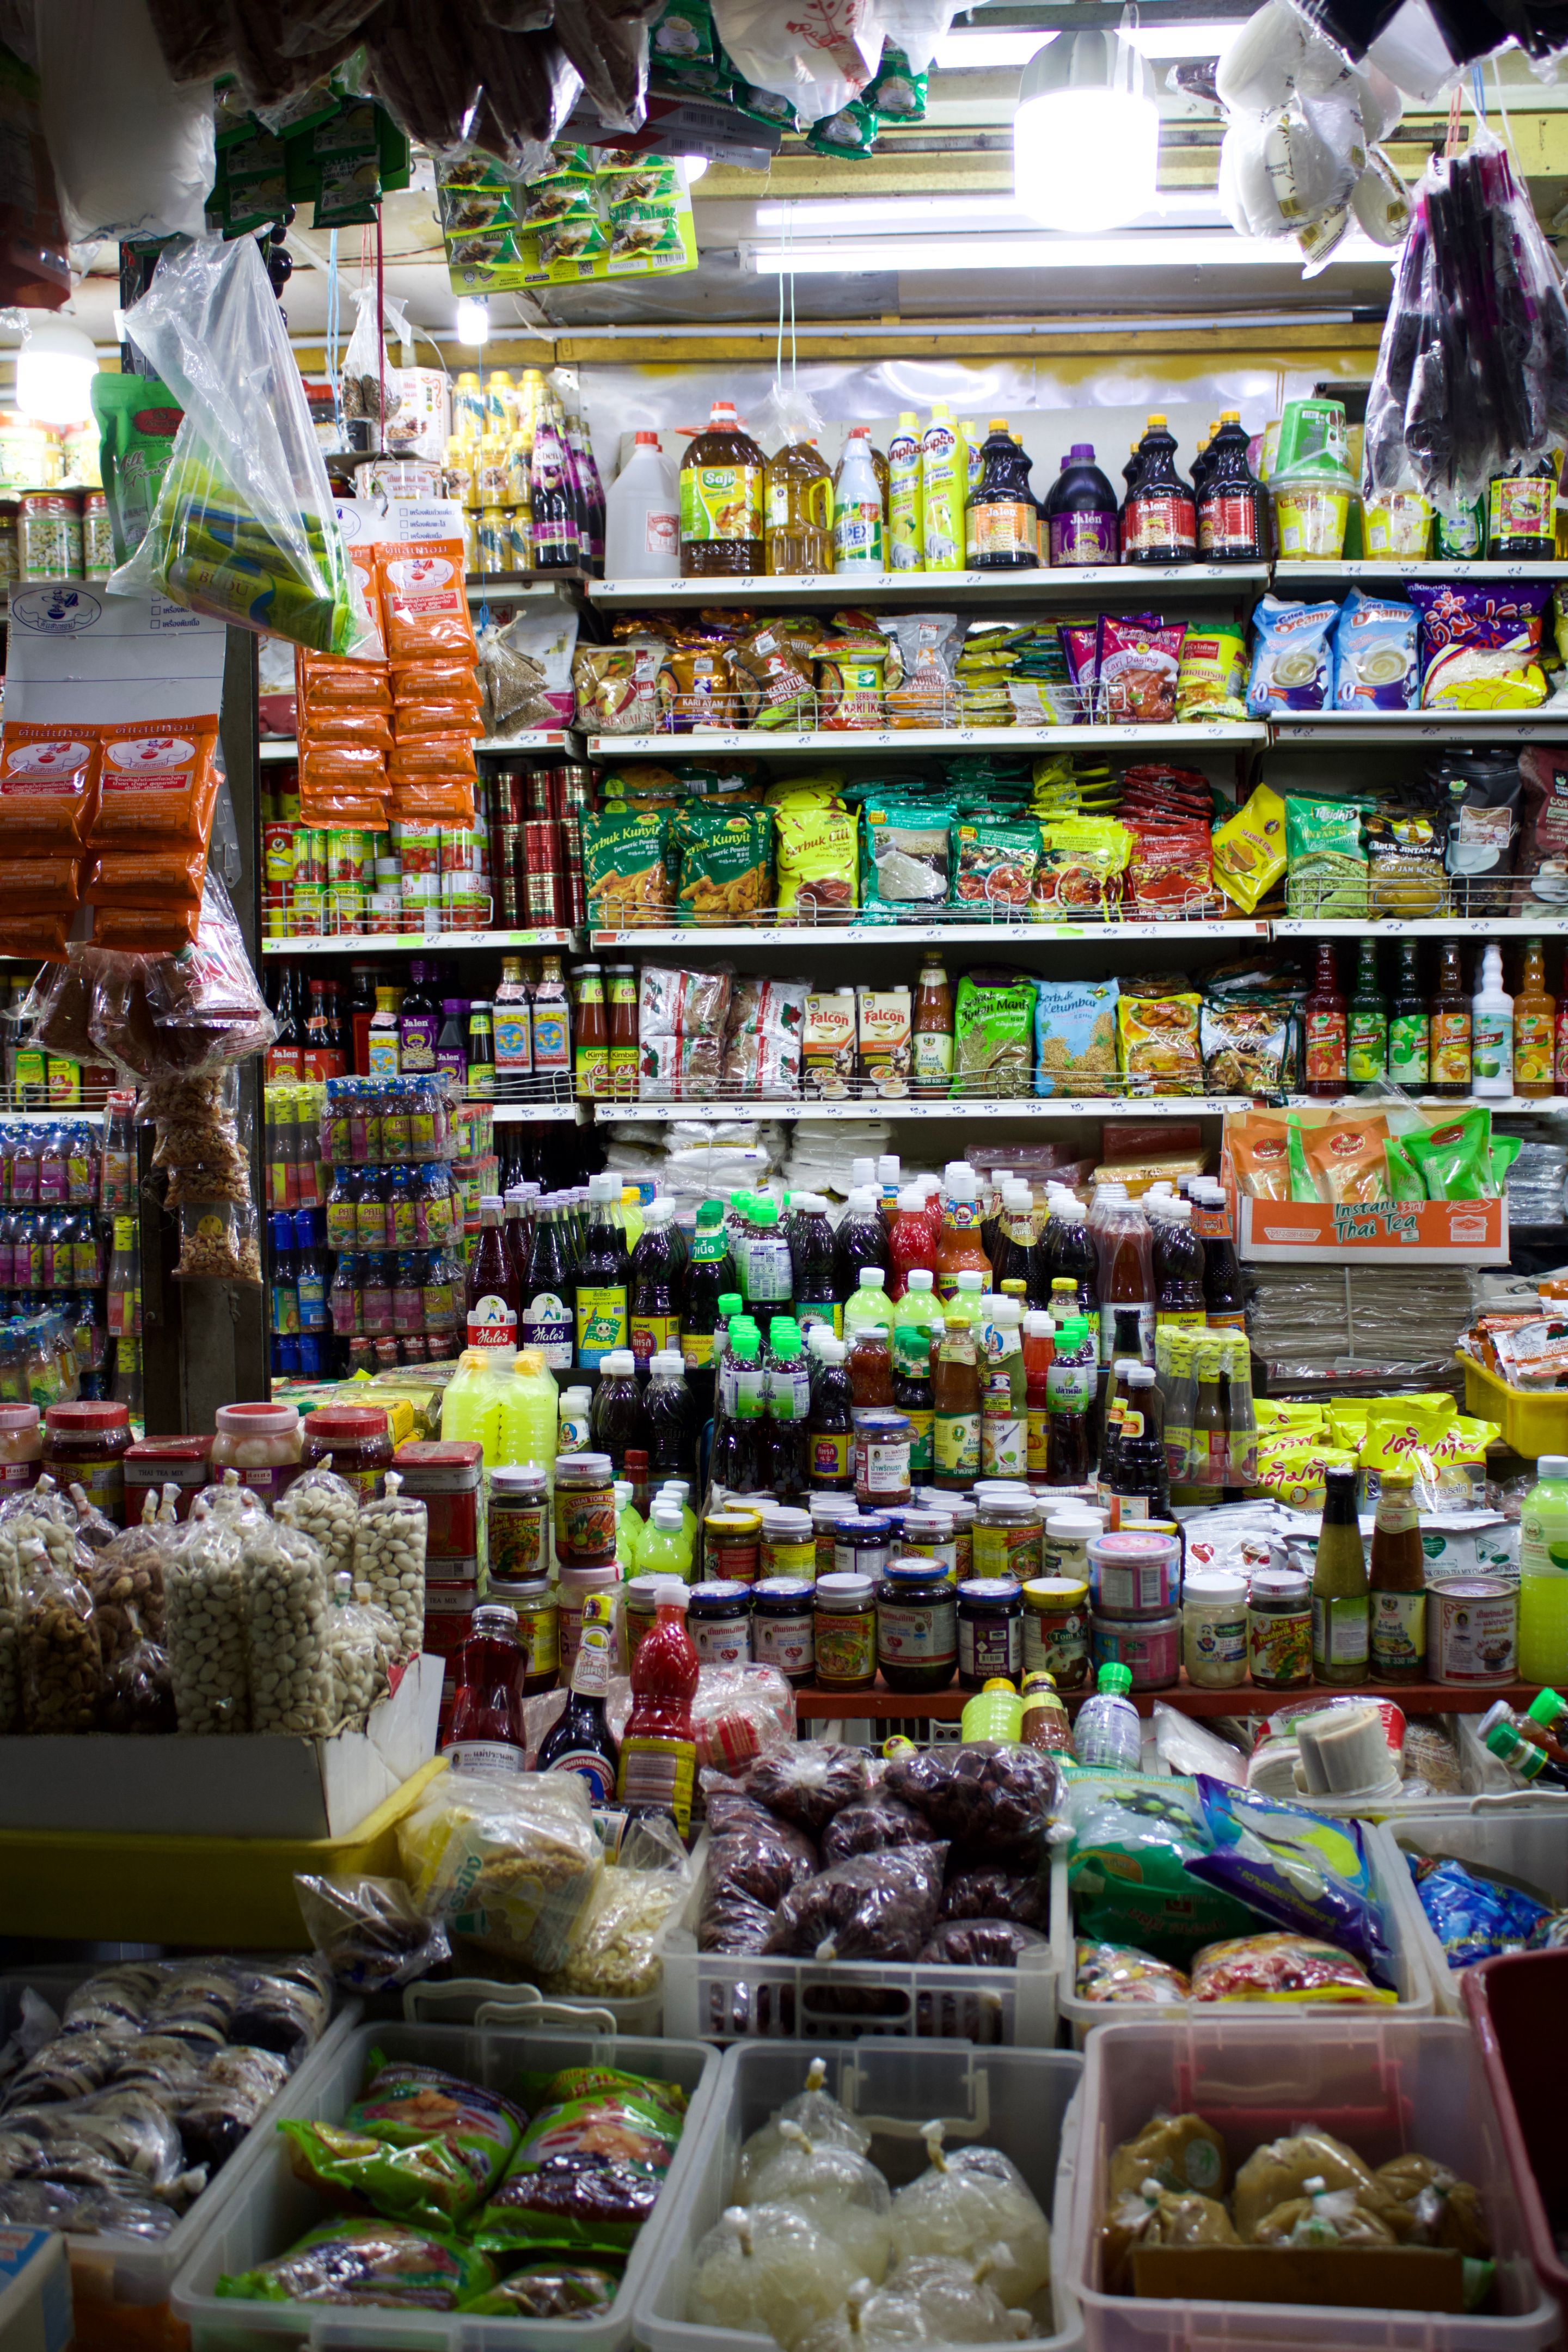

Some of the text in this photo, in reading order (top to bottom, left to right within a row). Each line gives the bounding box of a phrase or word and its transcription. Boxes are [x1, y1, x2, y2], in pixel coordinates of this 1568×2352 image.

[705, 471, 734, 486] Saji
[892, 503, 912, 514] Lemon
[1138, 501, 1167, 513] Jalen
[1070, 513, 1102, 525] Jalen
[1274, 610, 1334, 634] Dreamy
[1104, 655, 1159, 675] Kari Daging
[916, 666, 939, 676] SERBUK
[766, 673, 807, 697] KERUTUK
[911, 674, 947, 685] KURMA
[855, 692, 878, 701] SERBUK
[702, 700, 724, 708] AYAM
[844, 703, 866, 713] KARI
[341, 834, 363, 842] Kimball
[584, 824, 660, 859] Serbuk Kunyit
[712, 832, 751, 846] Kunyit
[613, 838, 660, 854] Turmeric Powder
[785, 827, 850, 861] Serbuk Cili
[729, 846, 750, 854] Powder
[1399, 846, 1430, 854] JINTAN
[996, 999, 1030, 1012] Manis
[1044, 998, 1098, 1017] Ketumbar
[810, 1011, 849, 1027] Falcon
[864, 1009, 905, 1025] Falcon
[403, 1018, 429, 1028] Jalen
[272, 1050, 298, 1059] Jalen
[437, 1052, 460, 1061] Jalen
[1012, 1227, 1031, 1236] อันดับ
[1331, 1212, 1418, 1244] Thai Tea
[476, 1327, 509, 1345] Hale's
[534, 1324, 565, 1343] Hale's
[632, 1336, 652, 1347] ทิพรส
[1525, 1348, 1552, 1360] Rempah
[1055, 1385, 1082, 1395] ปลาหมึก
[817, 1445, 835, 1456] ทิพรส
[871, 1463, 902, 1472] น้ำพริกนรก
[572, 1497, 587, 1507] THAI
[513, 1517, 540, 1527] Segera
[1434, 1568, 1450, 1577] GREEN
[1271, 1620, 1290, 1630] Pes
[473, 1749, 514, 1762] แม่ประนอม
